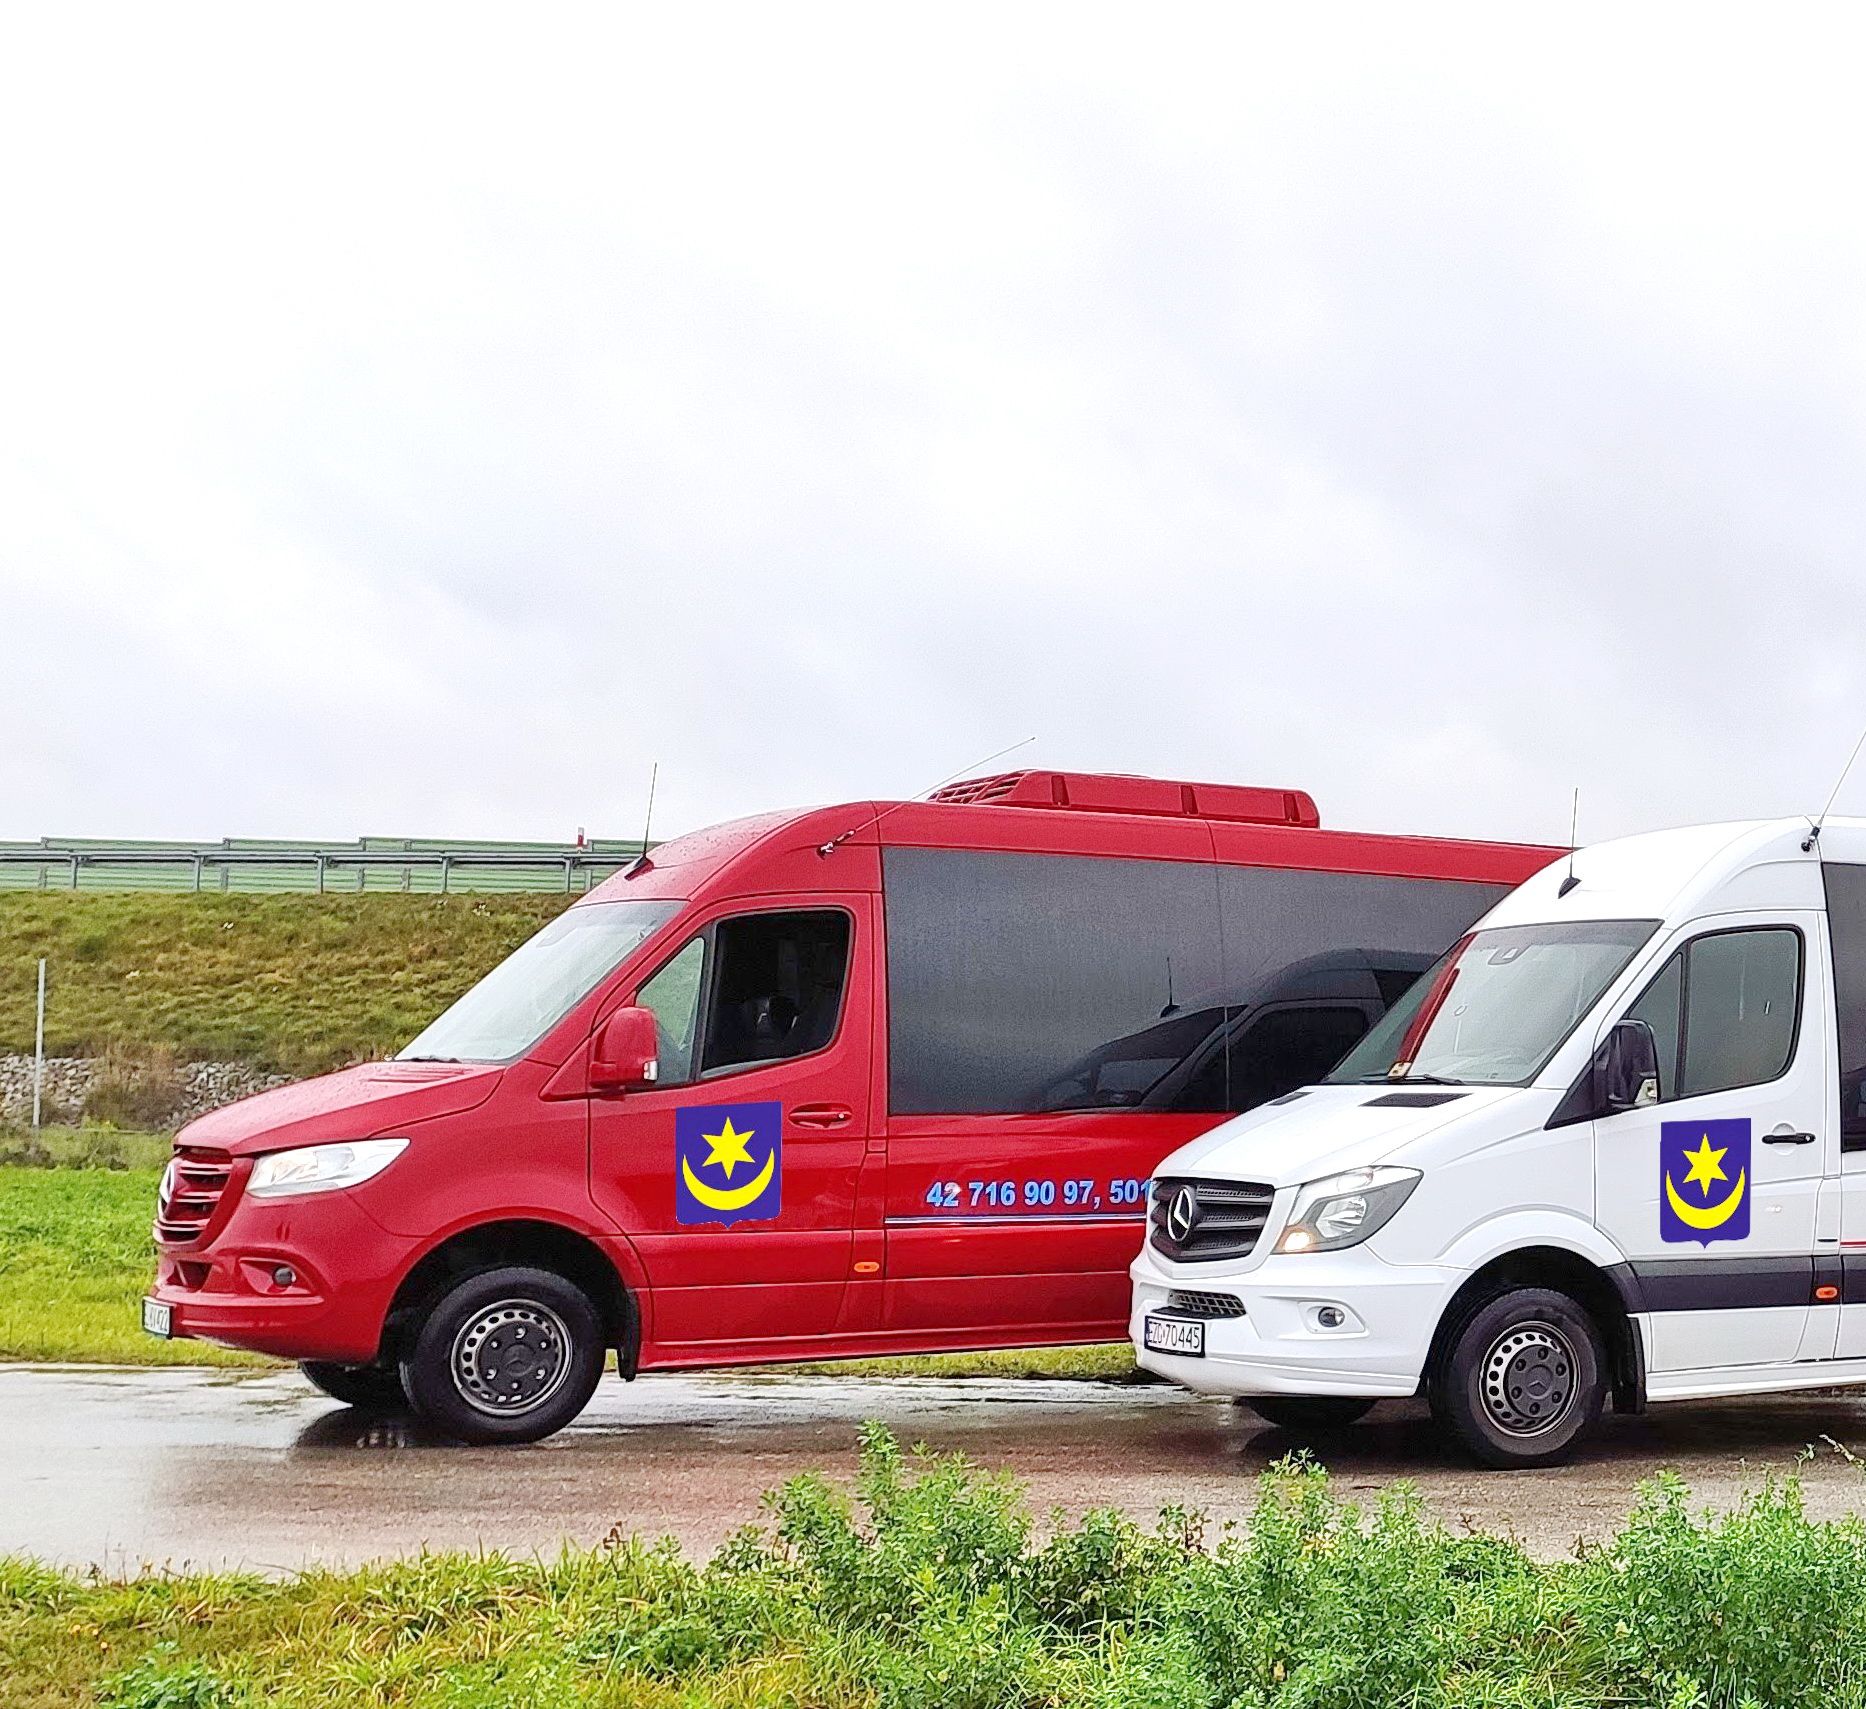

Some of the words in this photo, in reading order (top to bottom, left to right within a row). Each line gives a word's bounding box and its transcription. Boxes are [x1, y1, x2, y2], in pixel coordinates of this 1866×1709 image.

[927, 1181, 959, 1207] 42
[968, 1181, 1016, 1206] 716
[1024, 1180, 1055, 1205] 90
[1063, 1179, 1100, 1210] 97,
[1165, 1323, 1200, 1349] 70445
